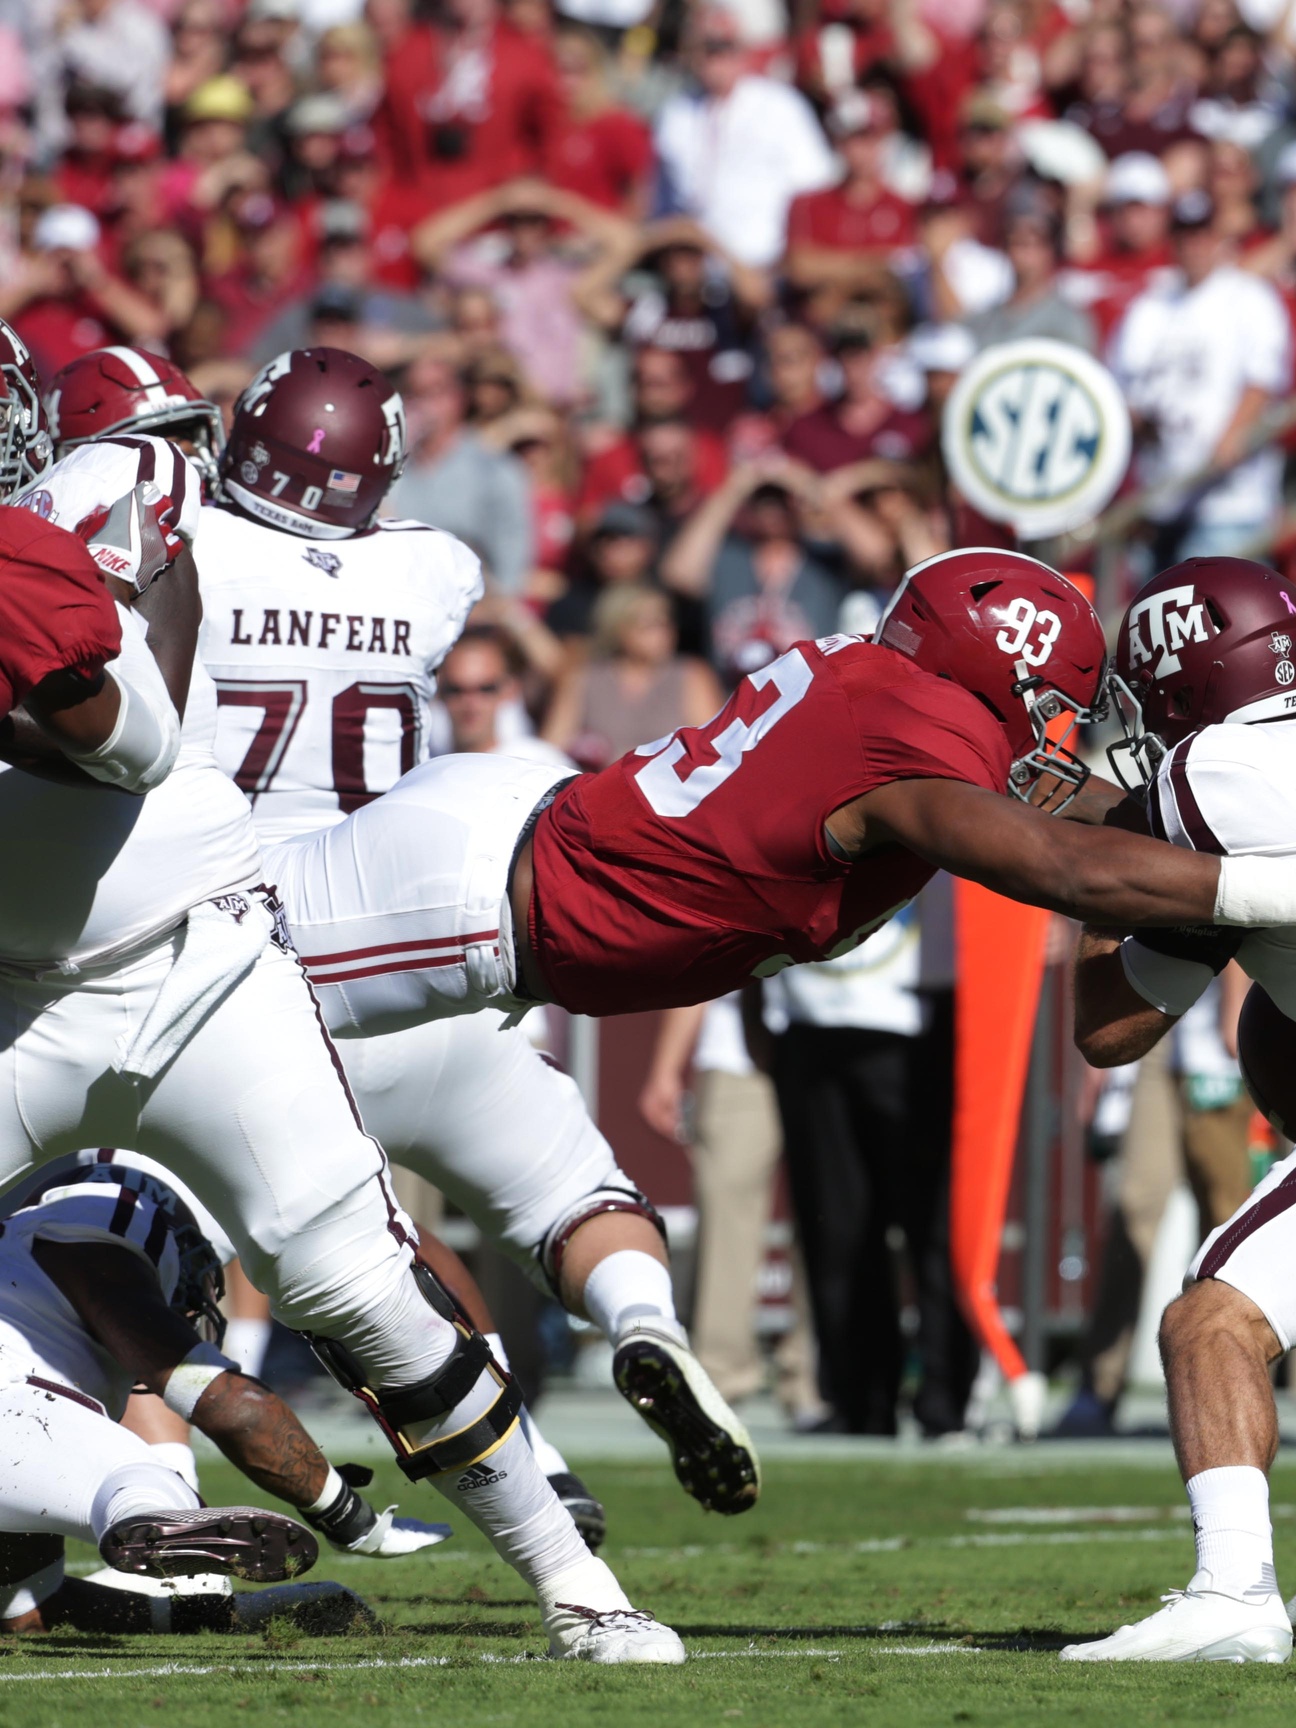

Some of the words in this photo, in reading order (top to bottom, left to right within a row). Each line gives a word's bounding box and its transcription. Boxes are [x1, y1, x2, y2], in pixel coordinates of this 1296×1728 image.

[972, 367, 1102, 498] SEC
[97, 548, 131, 573] NIKE
[231, 608, 412, 656] LANFEAR
[996, 597, 1062, 667] 93
[1276, 661, 1295, 684] SEC
[213, 680, 422, 815] 70
[457, 1470, 508, 1491] adidas
